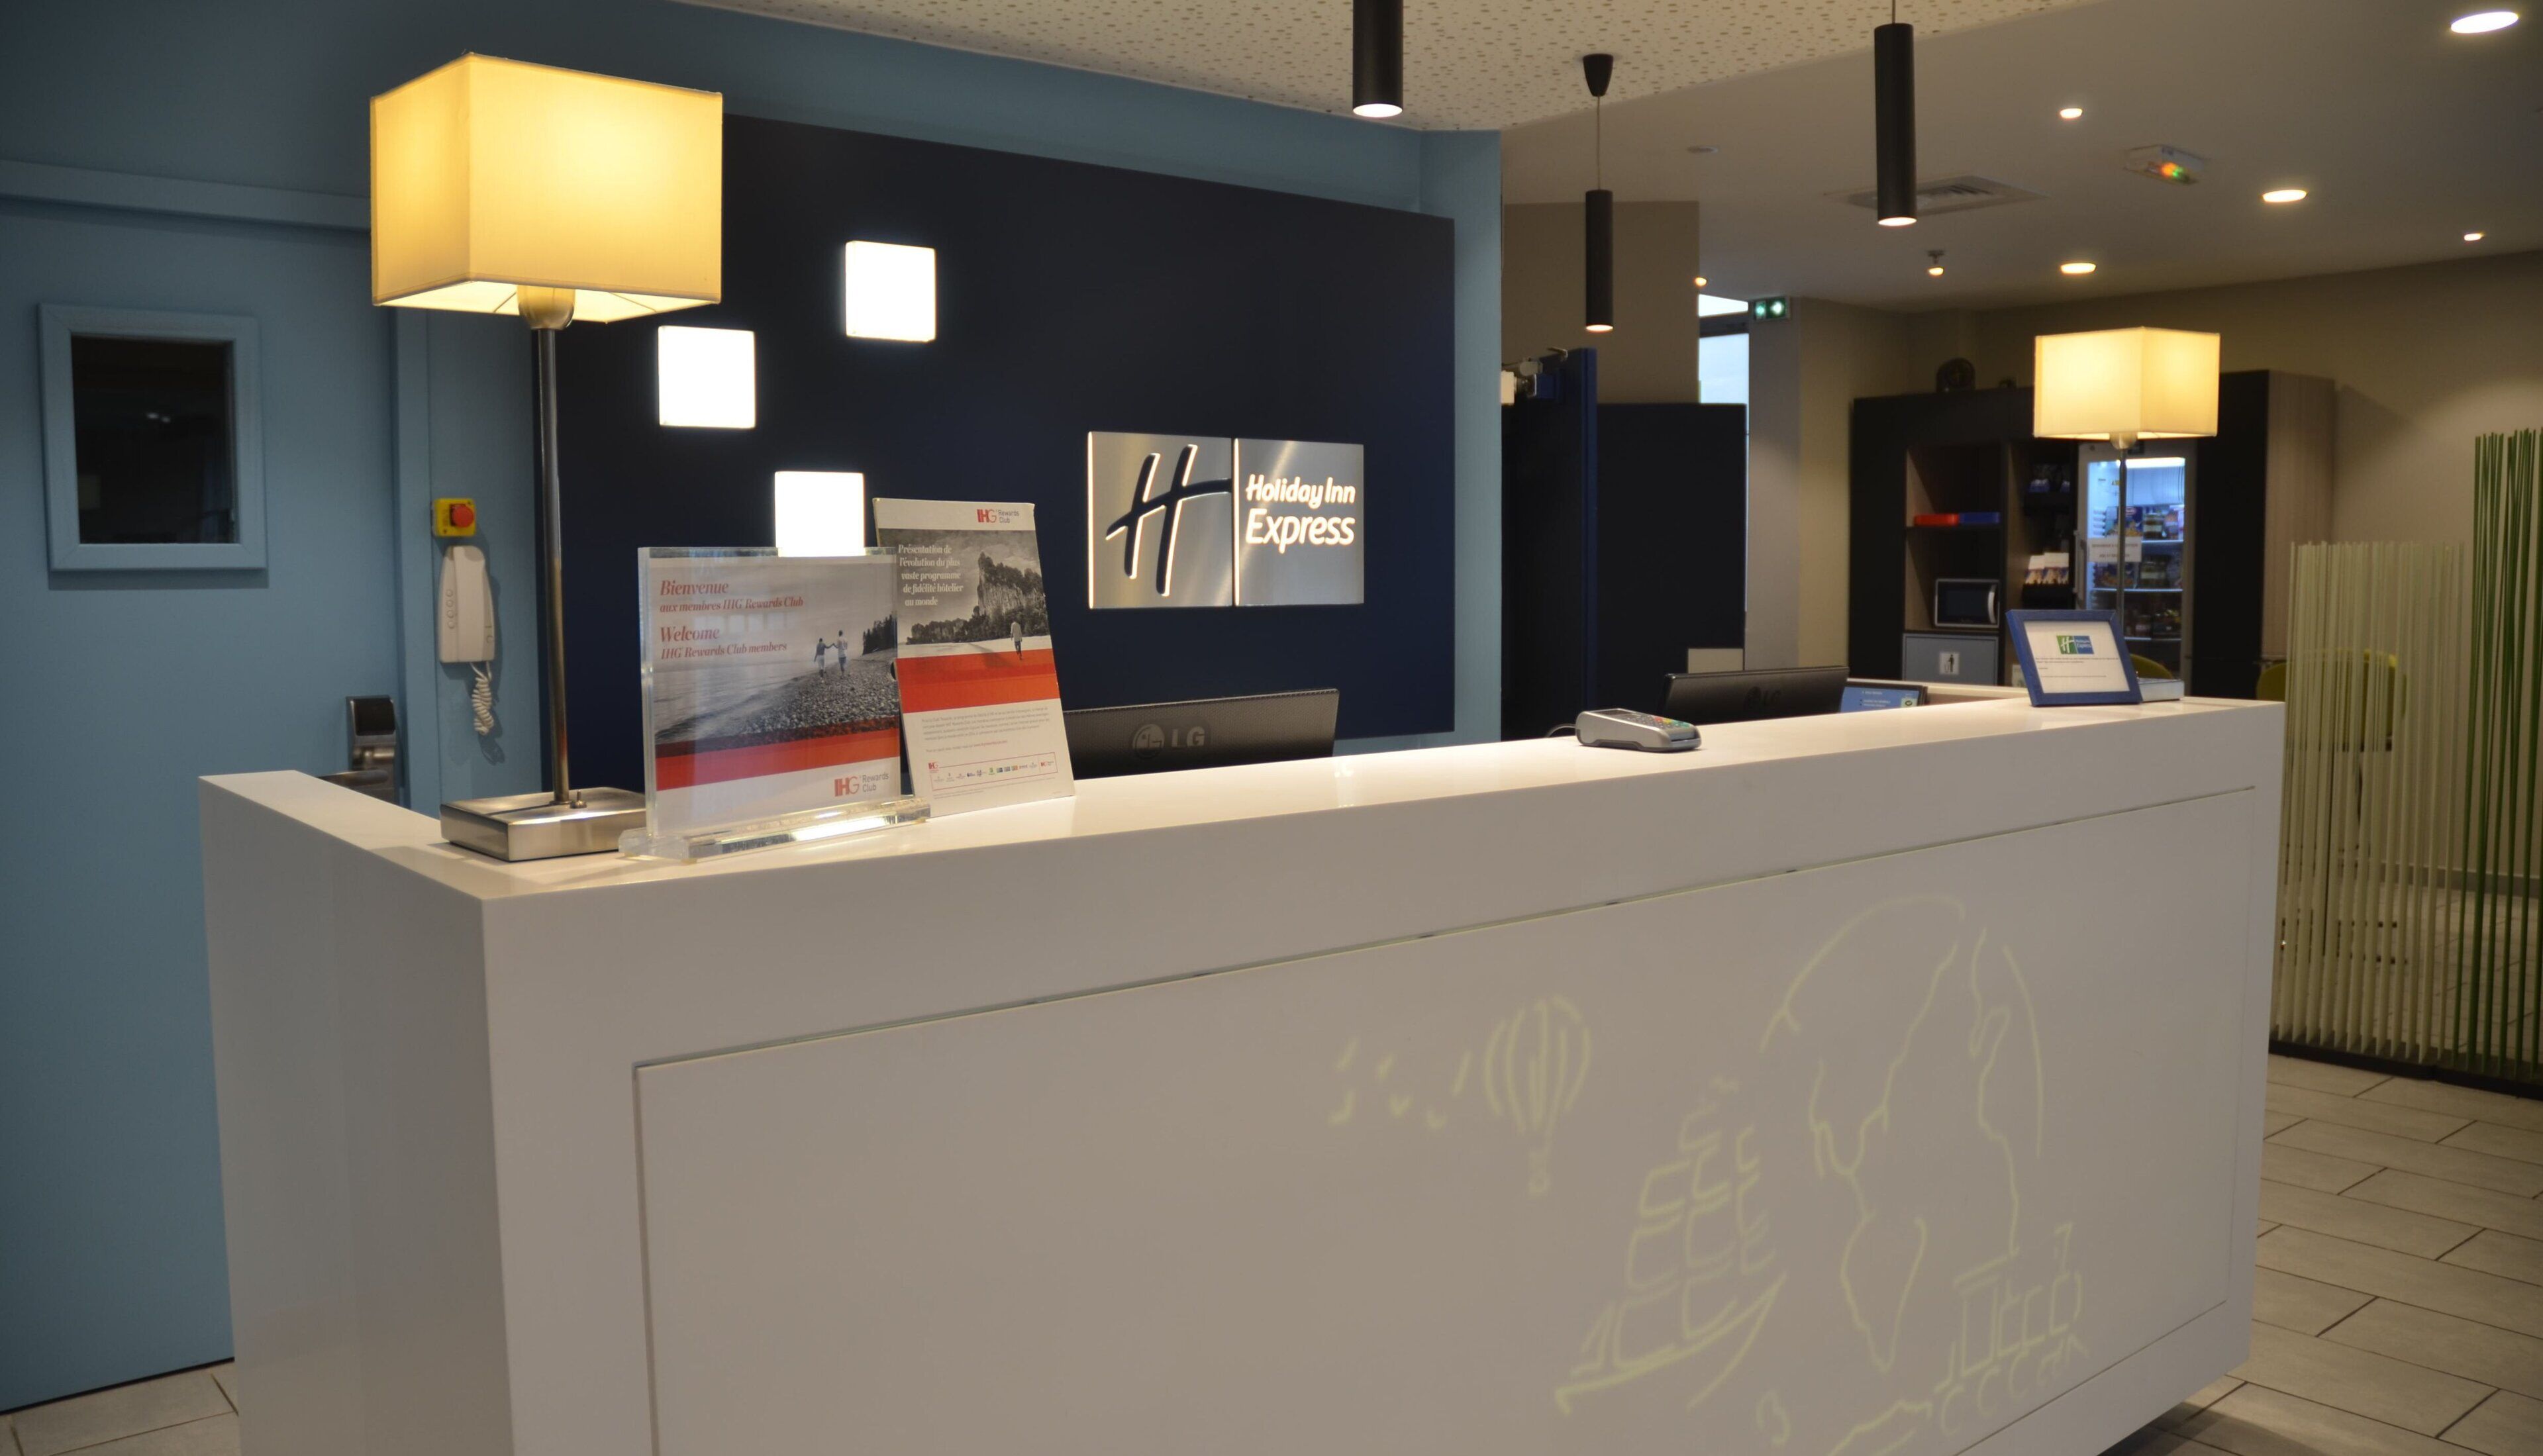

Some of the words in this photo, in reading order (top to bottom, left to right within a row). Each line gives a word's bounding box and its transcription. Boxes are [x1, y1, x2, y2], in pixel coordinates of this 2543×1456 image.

[1246, 473, 1324, 509] Holiday
[1325, 477, 1356, 503] Inn
[977, 509, 997, 523] IHG
[998, 509, 1020, 517] Rewards
[1245, 508, 1356, 554] Express
[898, 544, 942, 554] Présentation
[943, 544, 952, 554] de
[936, 557, 945, 567] du
[946, 558, 960, 569] plus
[901, 571, 919, 580] vaste
[920, 572, 961, 582] programme
[660, 579, 728, 596] Bienvenue
[903, 585, 911, 593] de
[912, 584, 936, 595] fidélité
[936, 583, 964, 593] hôtelier
[660, 604, 677, 613] aux
[679, 601, 721, 612] membres
[723, 599, 742, 610] IHG
[745, 597, 782, 609] Rewards
[783, 596, 804, 607] Club
[905, 598, 915, 607] au
[915, 597, 938, 607] monde
[660, 626, 720, 642] Welcome
[661, 648, 681, 659] IHG
[684, 645, 725, 657] Rewards
[726, 643, 747, 655] Club
[748, 642, 787, 654] members
[1171, 726, 1205, 748] LG
[834, 775, 860, 797] IHG
[862, 772, 889, 783] Rewards
[862, 783, 877, 793] Club
